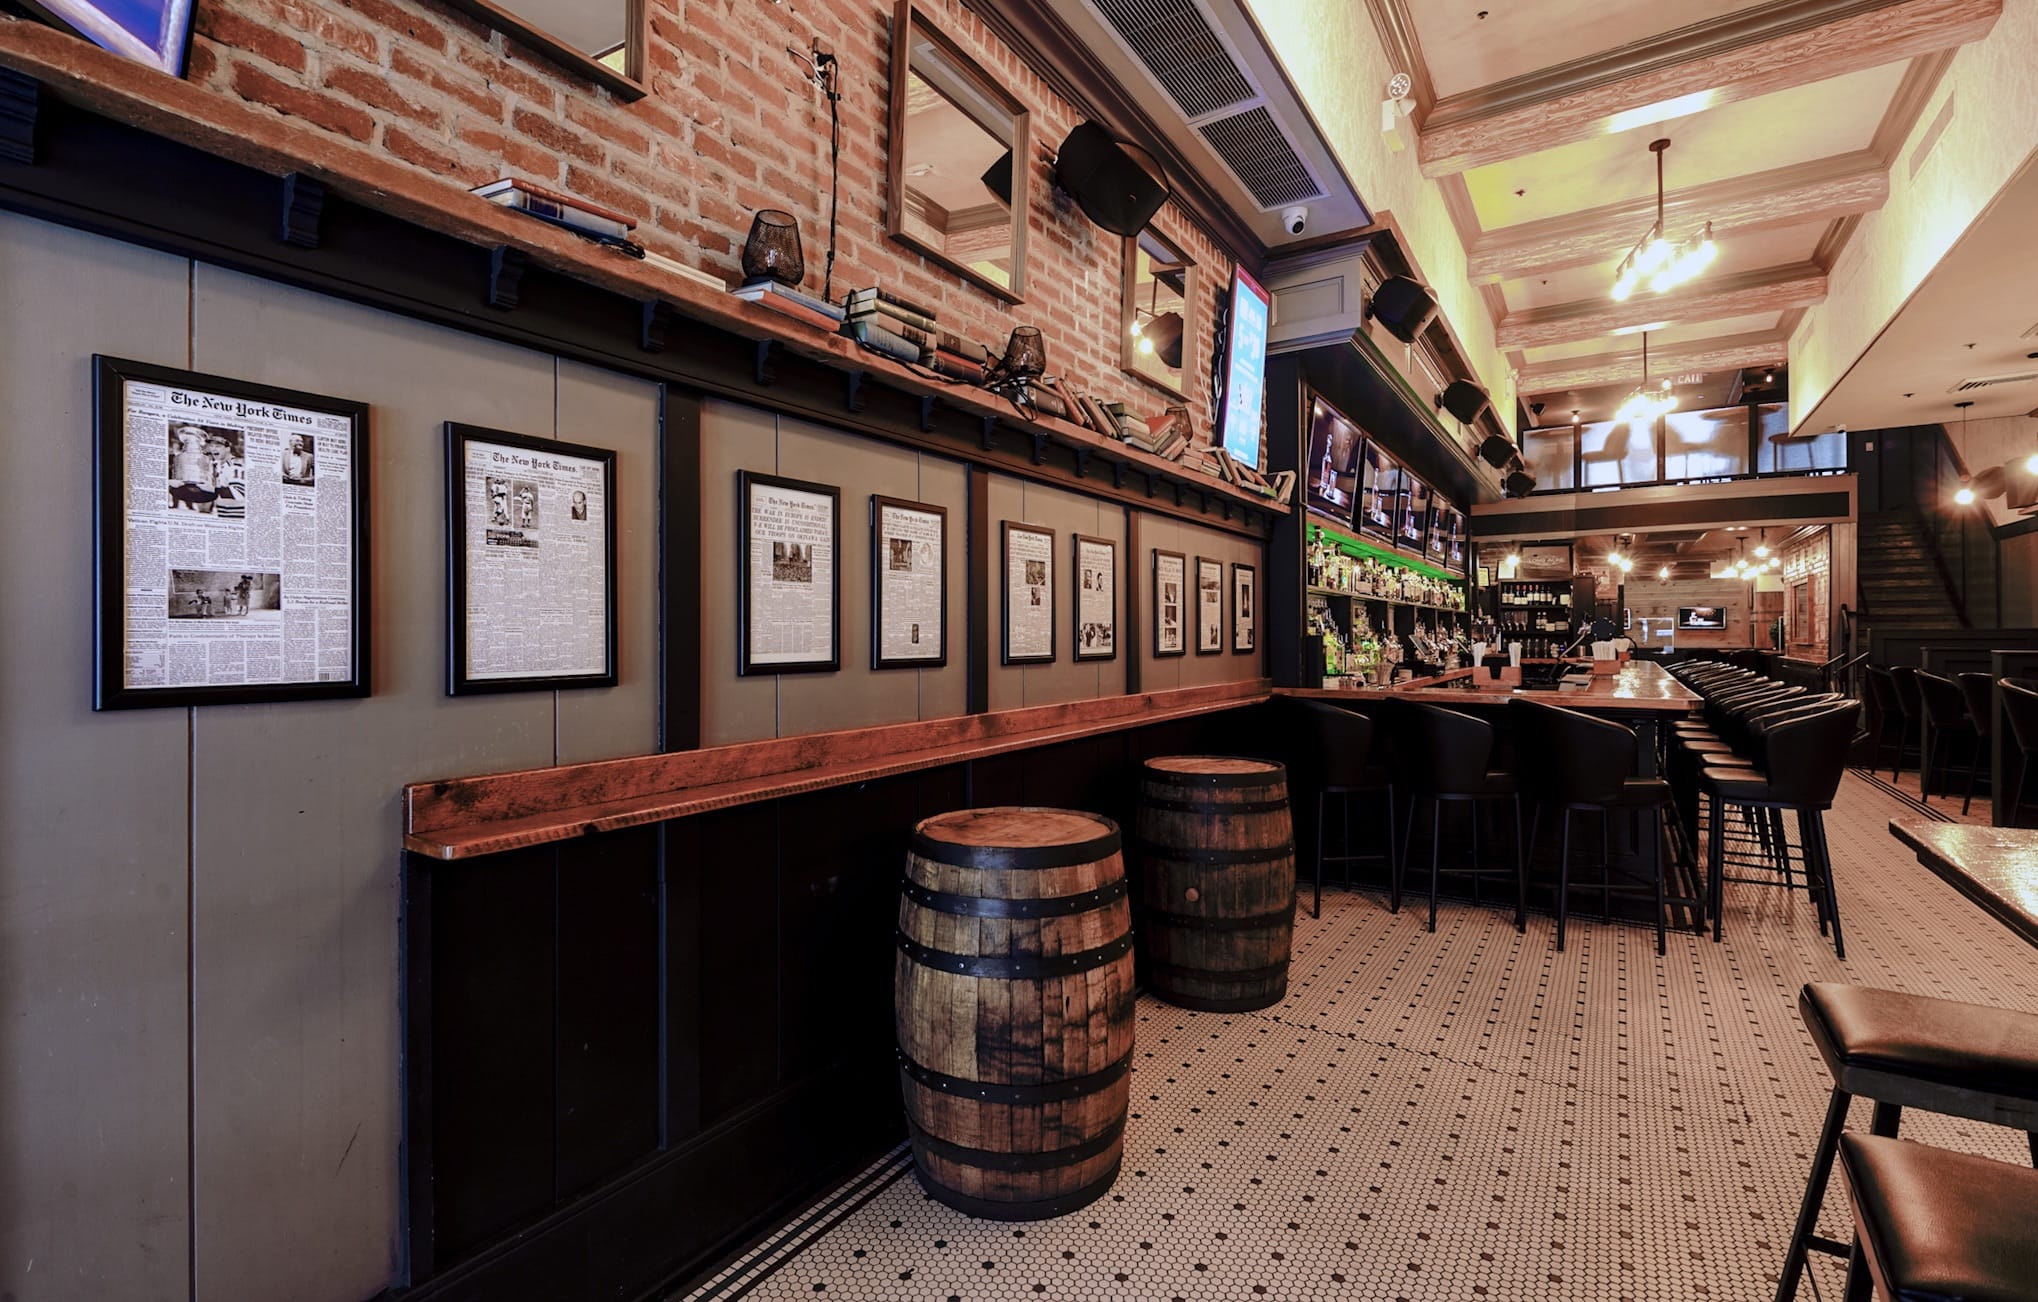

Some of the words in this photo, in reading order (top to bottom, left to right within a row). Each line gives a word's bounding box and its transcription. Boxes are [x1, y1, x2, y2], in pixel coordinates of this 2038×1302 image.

[171, 391, 199, 407] The
[202, 396, 233, 412] New
[236, 402, 270, 418] York
[272, 408, 313, 424] Times
[492, 452, 509, 463] The
[512, 455, 529, 465] New
[532, 458, 550, 469] York
